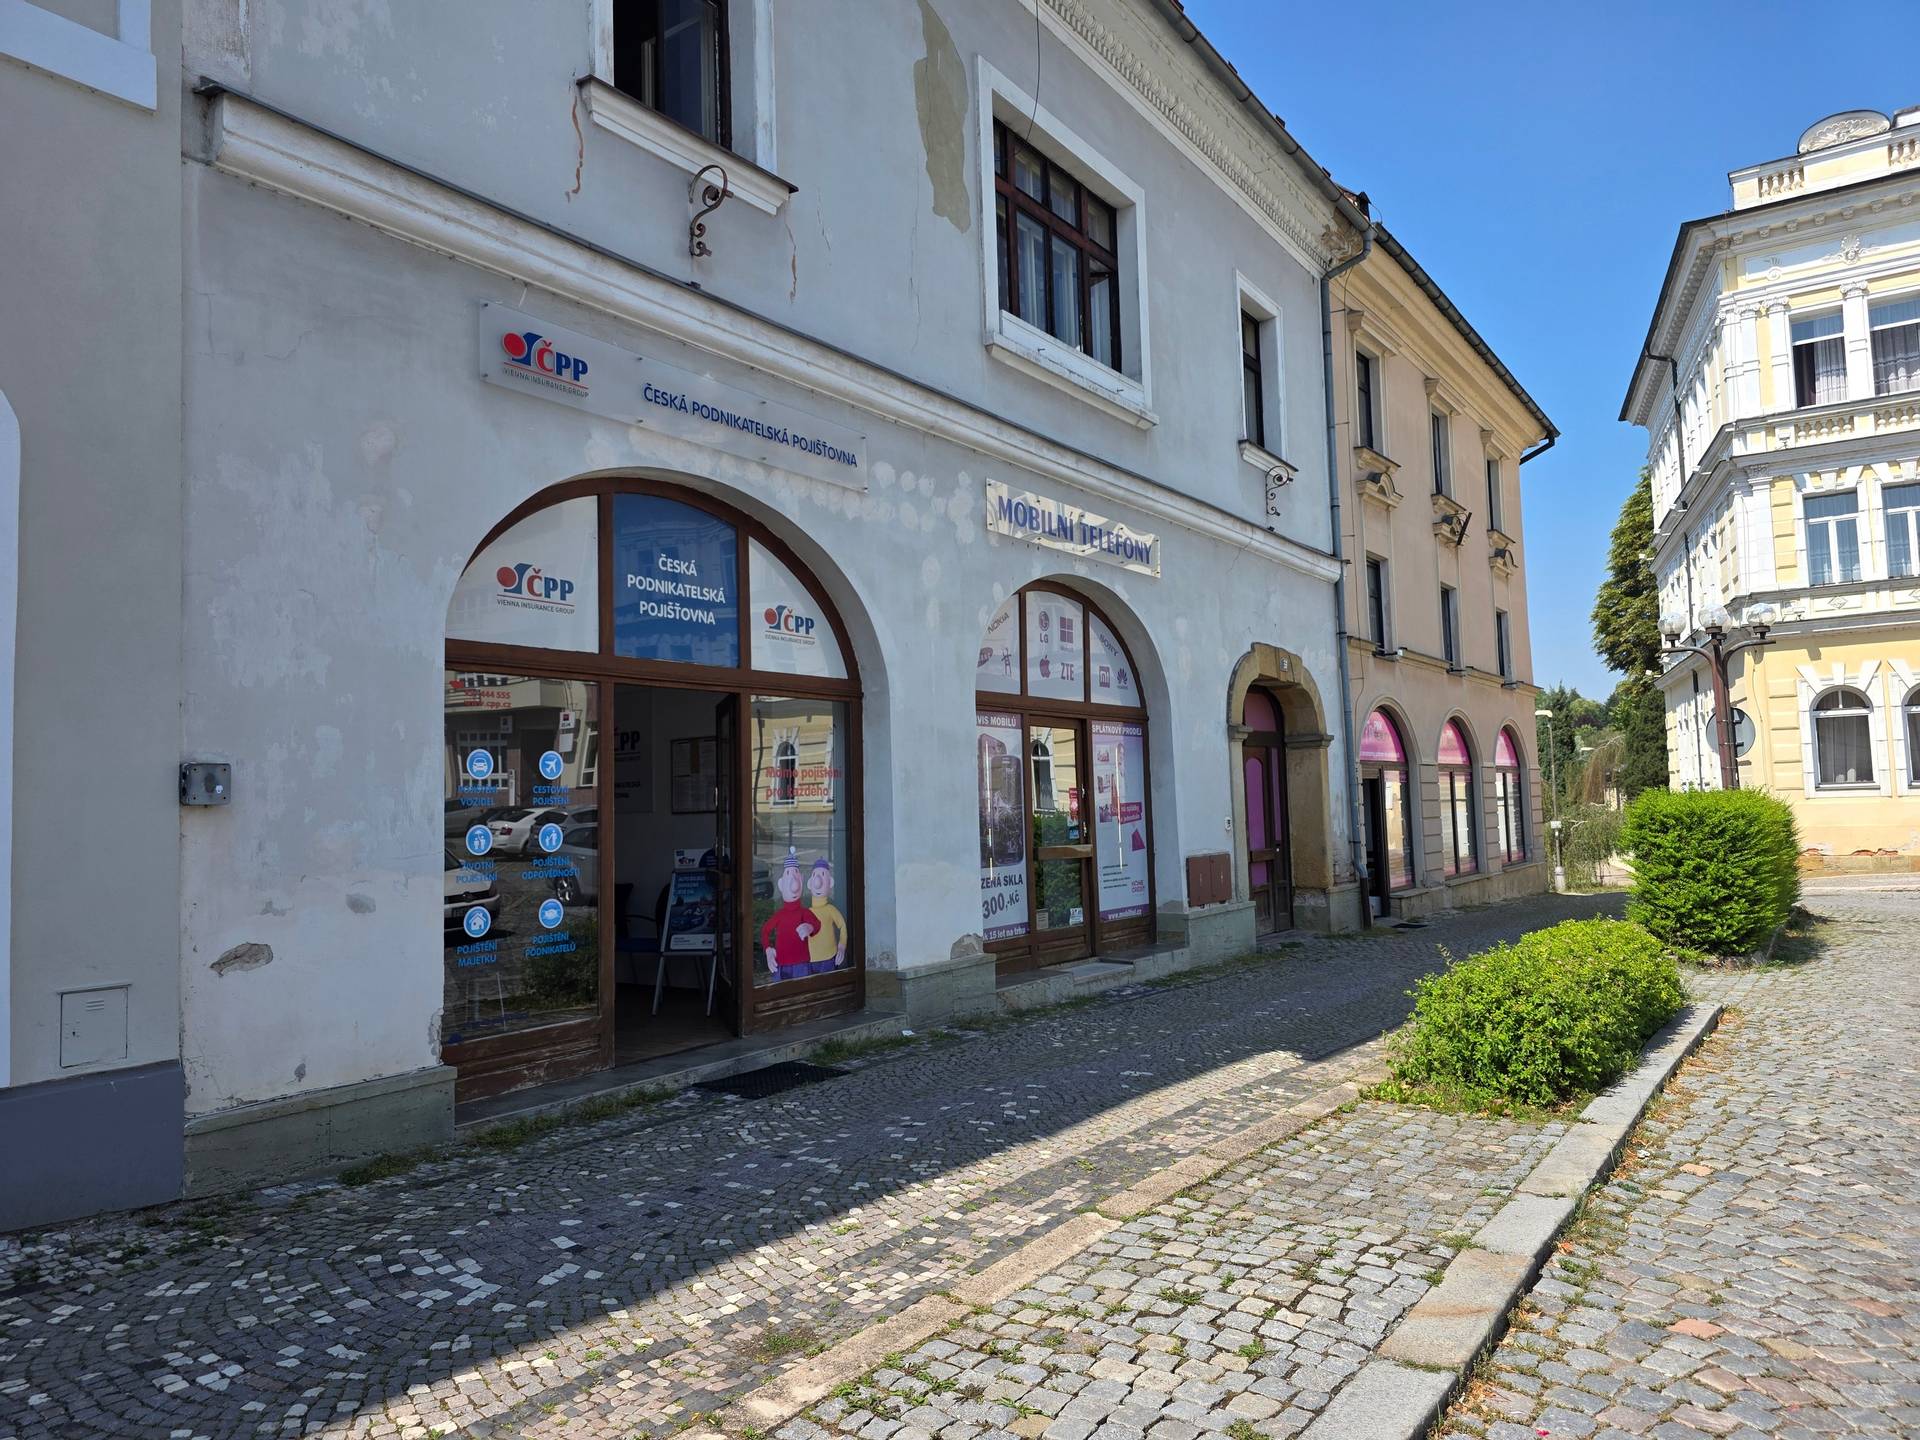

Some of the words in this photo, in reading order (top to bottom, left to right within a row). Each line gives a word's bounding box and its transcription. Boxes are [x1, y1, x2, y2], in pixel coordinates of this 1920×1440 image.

[536, 339, 589, 383] ČPP
[643, 383, 688, 414] ČESKÁ
[692, 401, 790, 446] PODNIKATELSKÁ
[793, 434, 858, 468] POJIŠŤOVNA
[998, 495, 1074, 542] MOBILNÍ
[1079, 521, 1152, 565] TELEFONY
[658, 553, 698, 577] ČESKÁ
[526, 567, 575, 602] ČPP
[627, 574, 726, 604] PODNIKATELSKÁ
[496, 599, 520, 609] VIENNA
[640, 601, 716, 626] POJIŠŤOVNA
[783, 608, 815, 636] ČPP
[1039, 633, 1049, 644] LG
[1060, 662, 1075, 681] ZTE
[1003, 873, 1024, 887] SKLA
